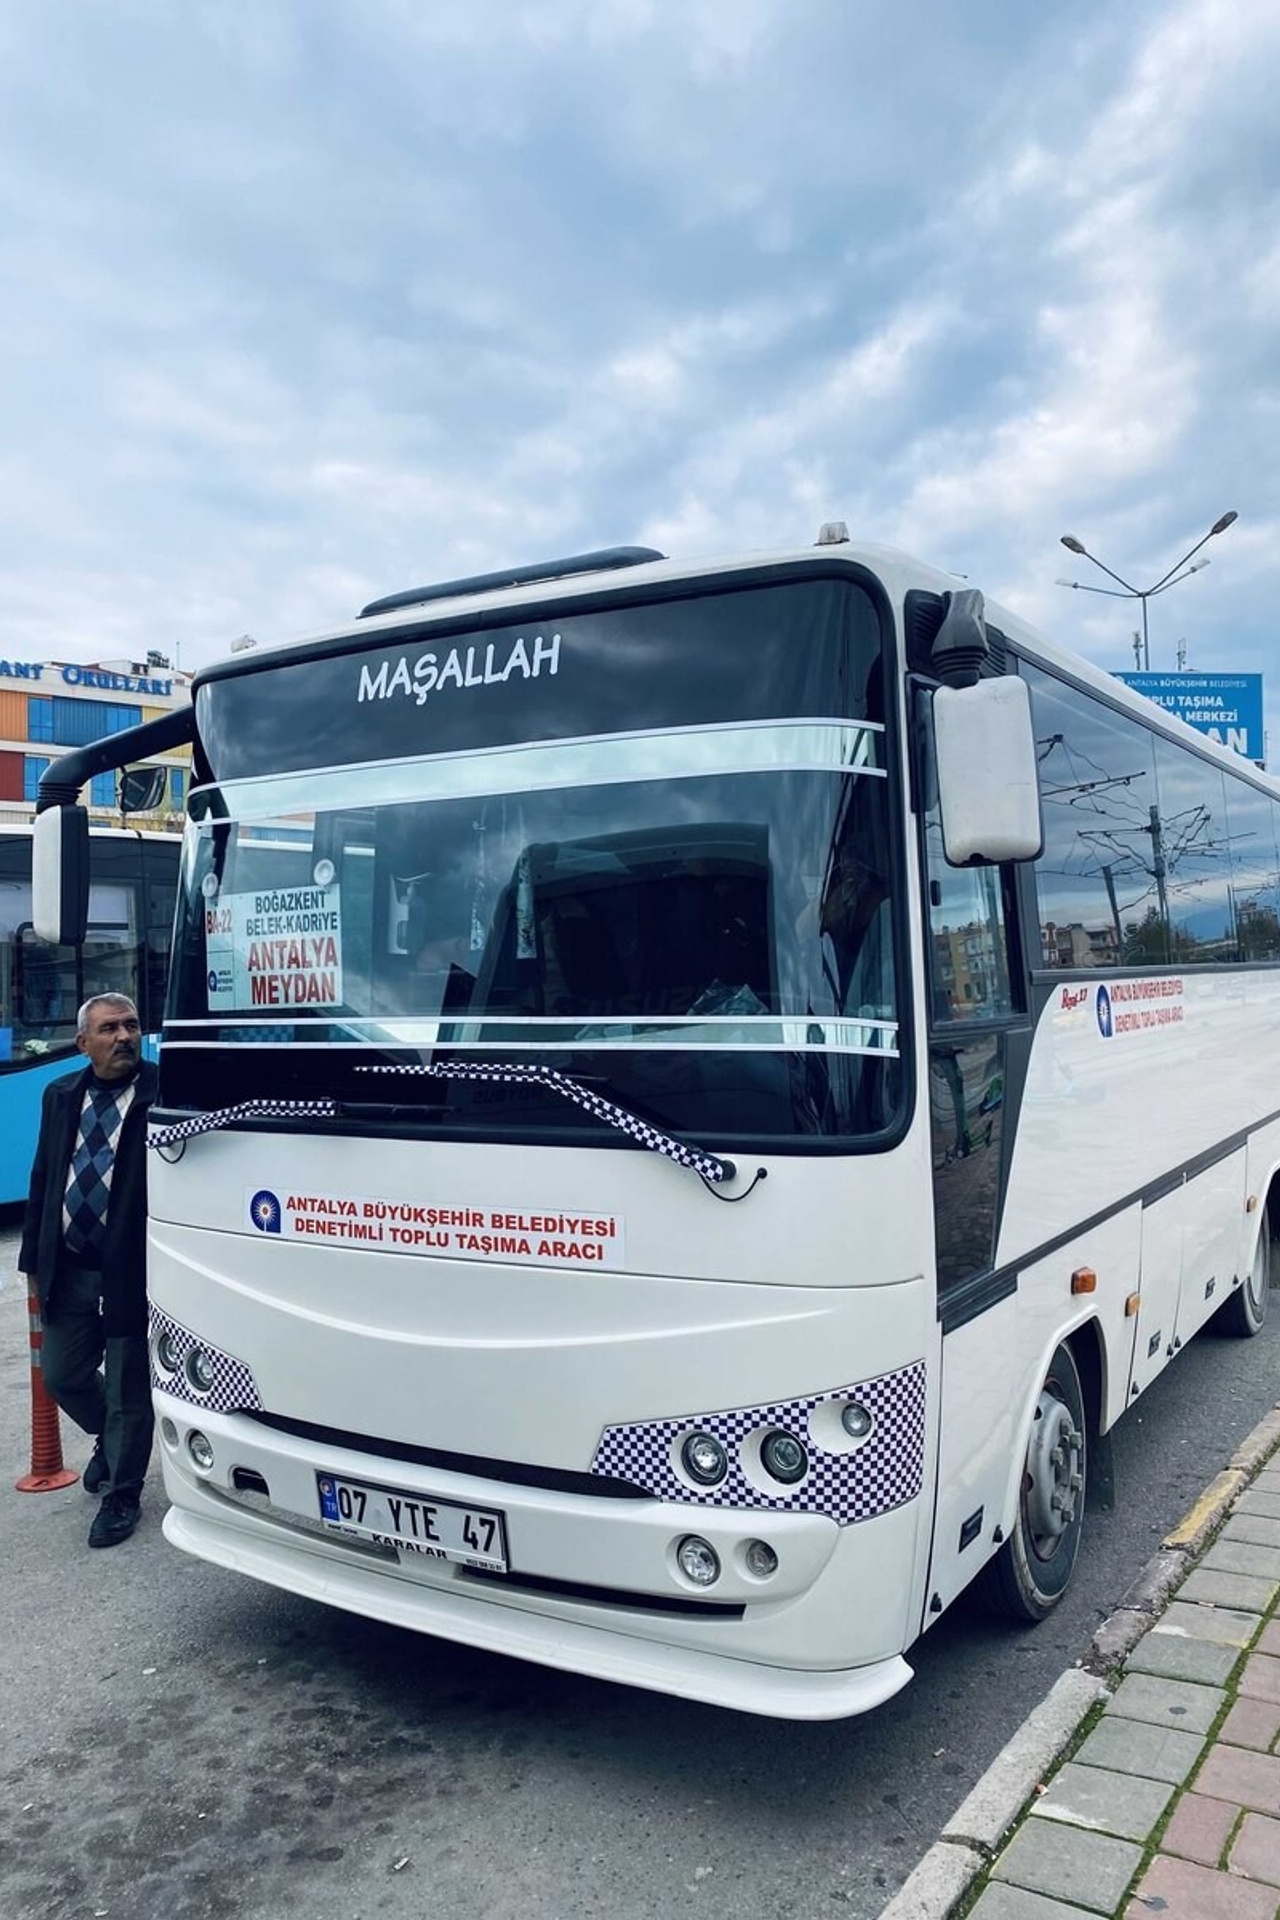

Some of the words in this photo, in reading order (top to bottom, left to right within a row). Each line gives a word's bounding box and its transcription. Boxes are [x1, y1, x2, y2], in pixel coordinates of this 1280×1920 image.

[357, 634, 561, 706] MAŞALLAH
[1177, 695, 1224, 709] TAŞIMA
[1185, 709, 1238, 723] MERKEZİ
[255, 890, 327, 914] BOĞAZKENT
[248, 937, 338, 971] ANTALYA
[252, 972, 335, 1005] MEYDAN
[286, 1196, 358, 1217] ANTALYA
[363, 1201, 484, 1229] BÜYÜKŞEHİR
[491, 1213, 616, 1238] BELEDİYESİ
[294, 1217, 383, 1241] DENETİMLİ
[388, 1227, 450, 1248] TOPLU
[455, 1233, 532, 1256] TAŞIMA
[537, 1240, 604, 1261] ARACI
[337, 1486, 367, 1523] 07
[387, 1498, 440, 1542] YTE
[462, 1514, 497, 1553] 47
[372, 1533, 448, 1560] KARALAR
